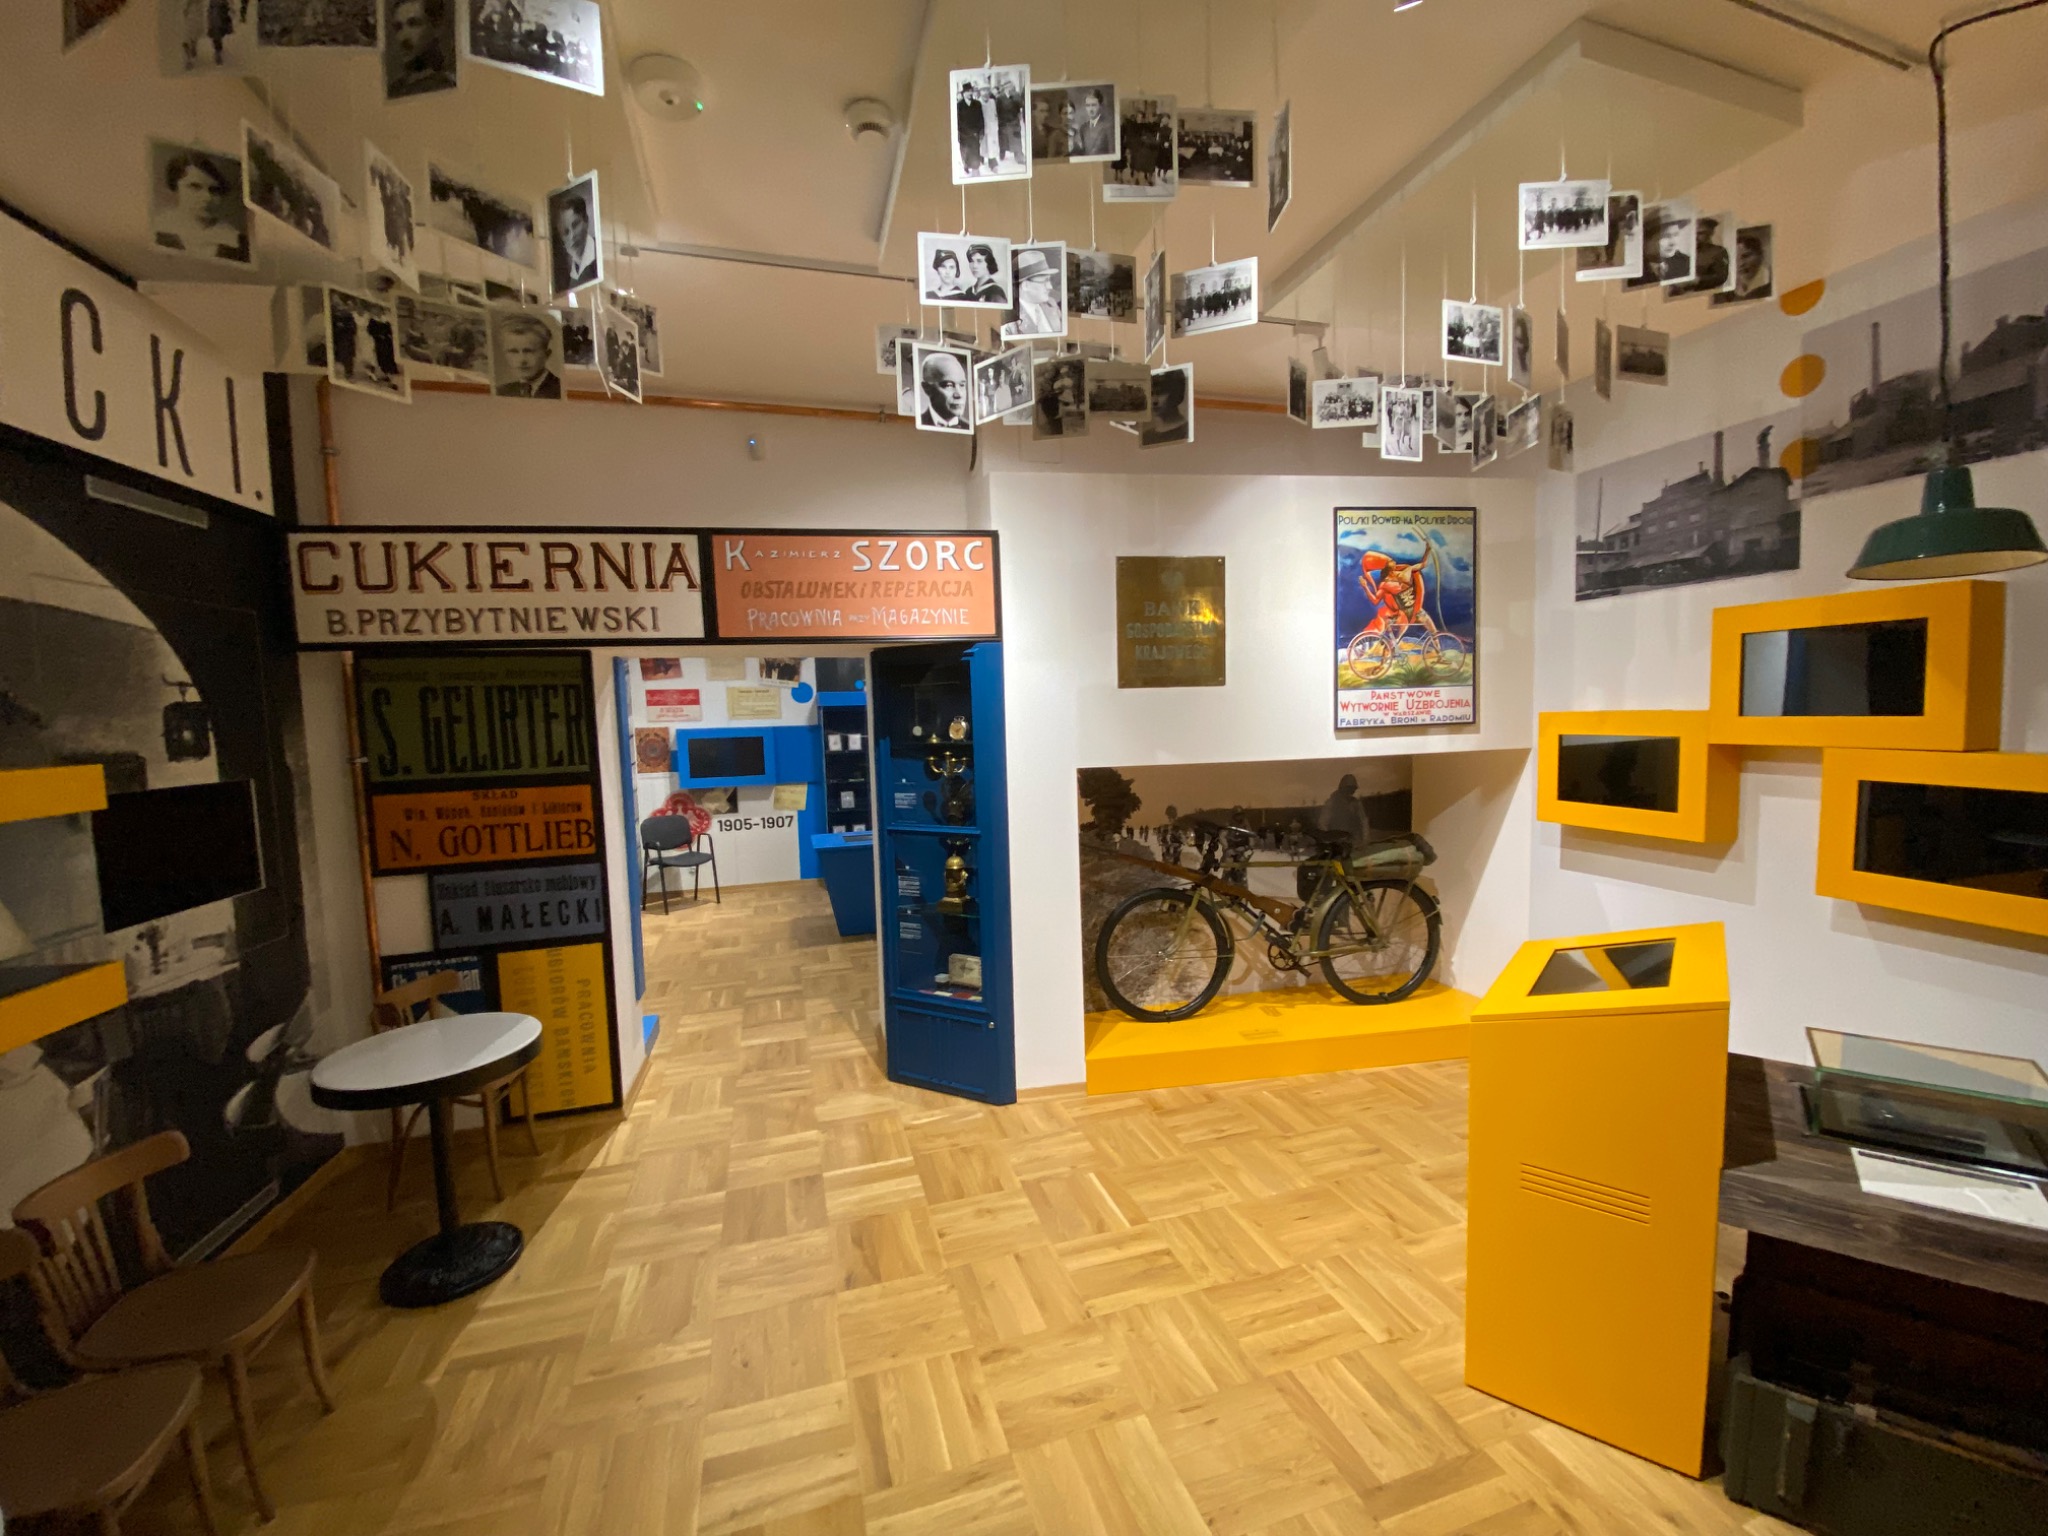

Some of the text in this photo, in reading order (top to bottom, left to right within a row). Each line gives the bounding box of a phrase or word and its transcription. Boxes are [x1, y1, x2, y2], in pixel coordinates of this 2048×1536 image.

[1339, 514, 1369, 525] POLSKI
[1414, 514, 1446, 525] POLSKIE
[296, 540, 702, 595] CUKIERNIA
[724, 539, 984, 571] KAZIMIERZ SZORC
[740, 580, 857, 600] OBSTALUNEK
[870, 580, 974, 598] REPERACJA
[747, 607, 842, 631] PRACOWNIA
[872, 606, 970, 630] MAGAZYNIE
[1406, 699, 1471, 710] UZBROJENIA
[371, 687, 412, 776] S.
[1340, 718, 1385, 727] FABRYKA
[1391, 716, 1418, 725] BRONI
[1430, 714, 1471, 723] RADOMIU
[717, 815, 794, 832] 1905-1907
[389, 818, 596, 862] N. GOTTLIEB
[440, 897, 601, 937] A. MAŁECKI
[576, 978, 598, 1075] PRACOWNIA
